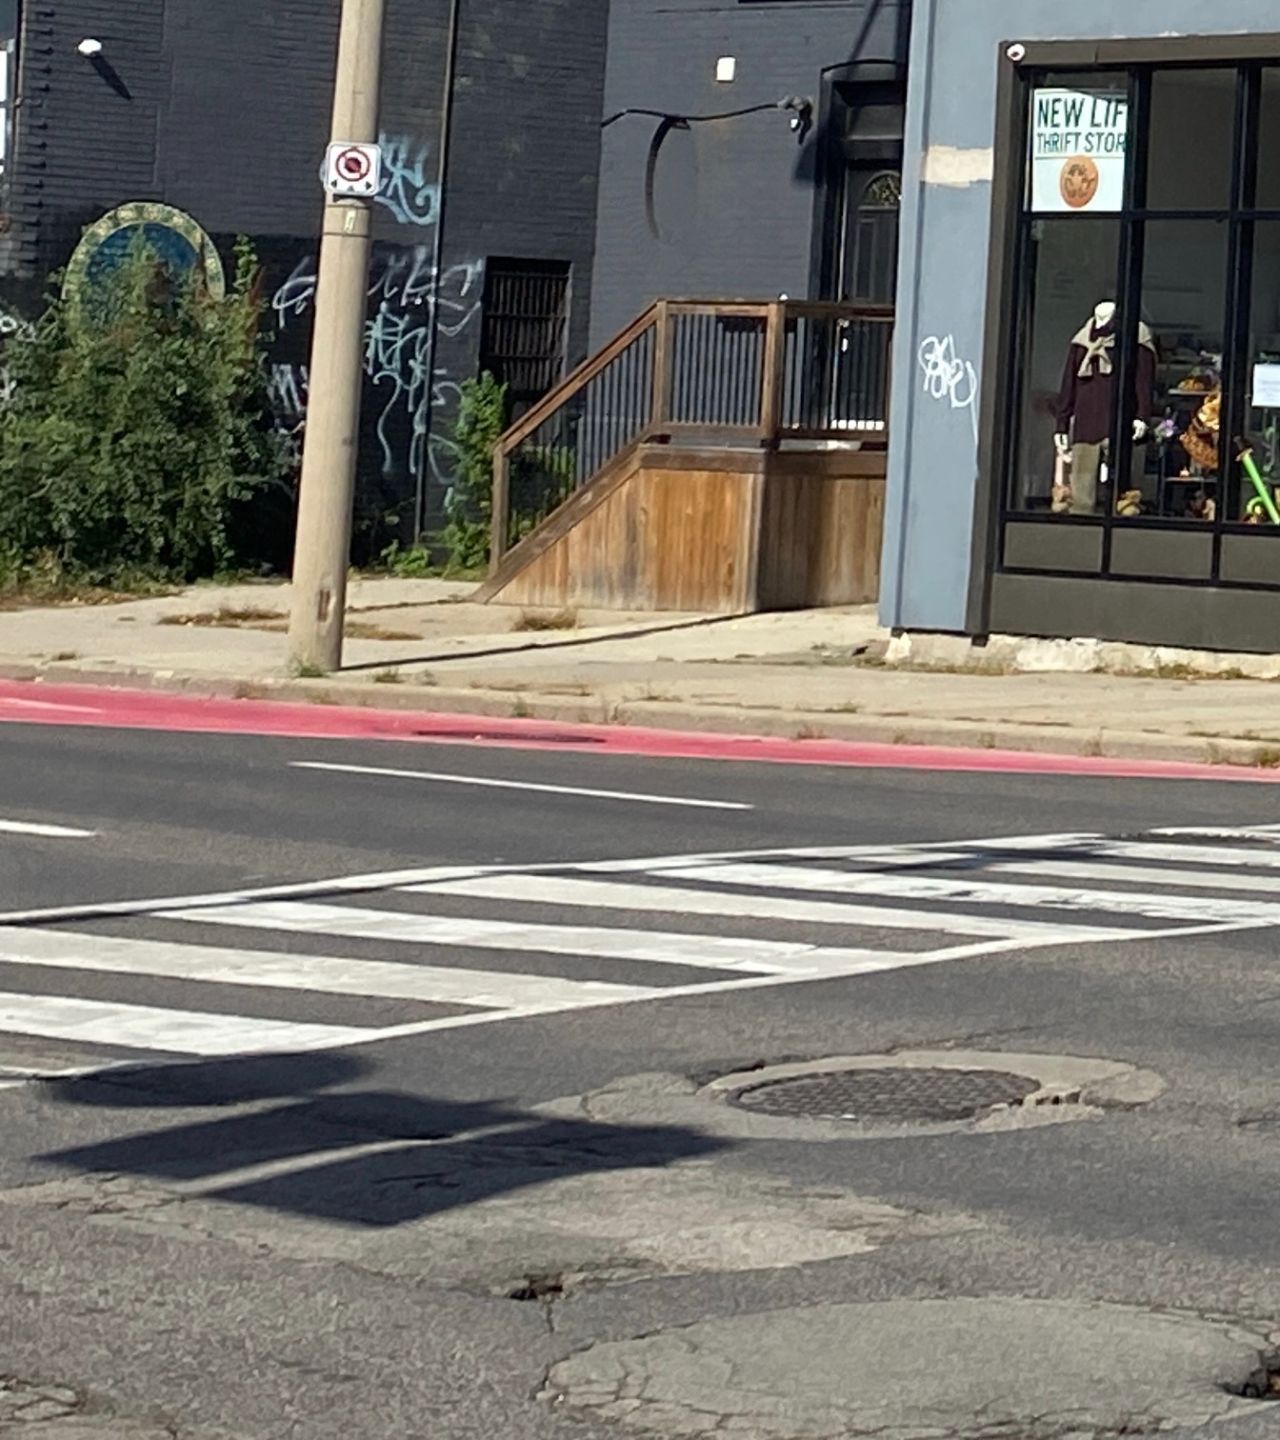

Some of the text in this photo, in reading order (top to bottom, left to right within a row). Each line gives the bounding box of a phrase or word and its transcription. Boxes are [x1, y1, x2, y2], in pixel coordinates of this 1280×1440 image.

[1038, 97, 1127, 128] NEW LIF
[1037, 132, 1126, 153] THRIFT STOR
